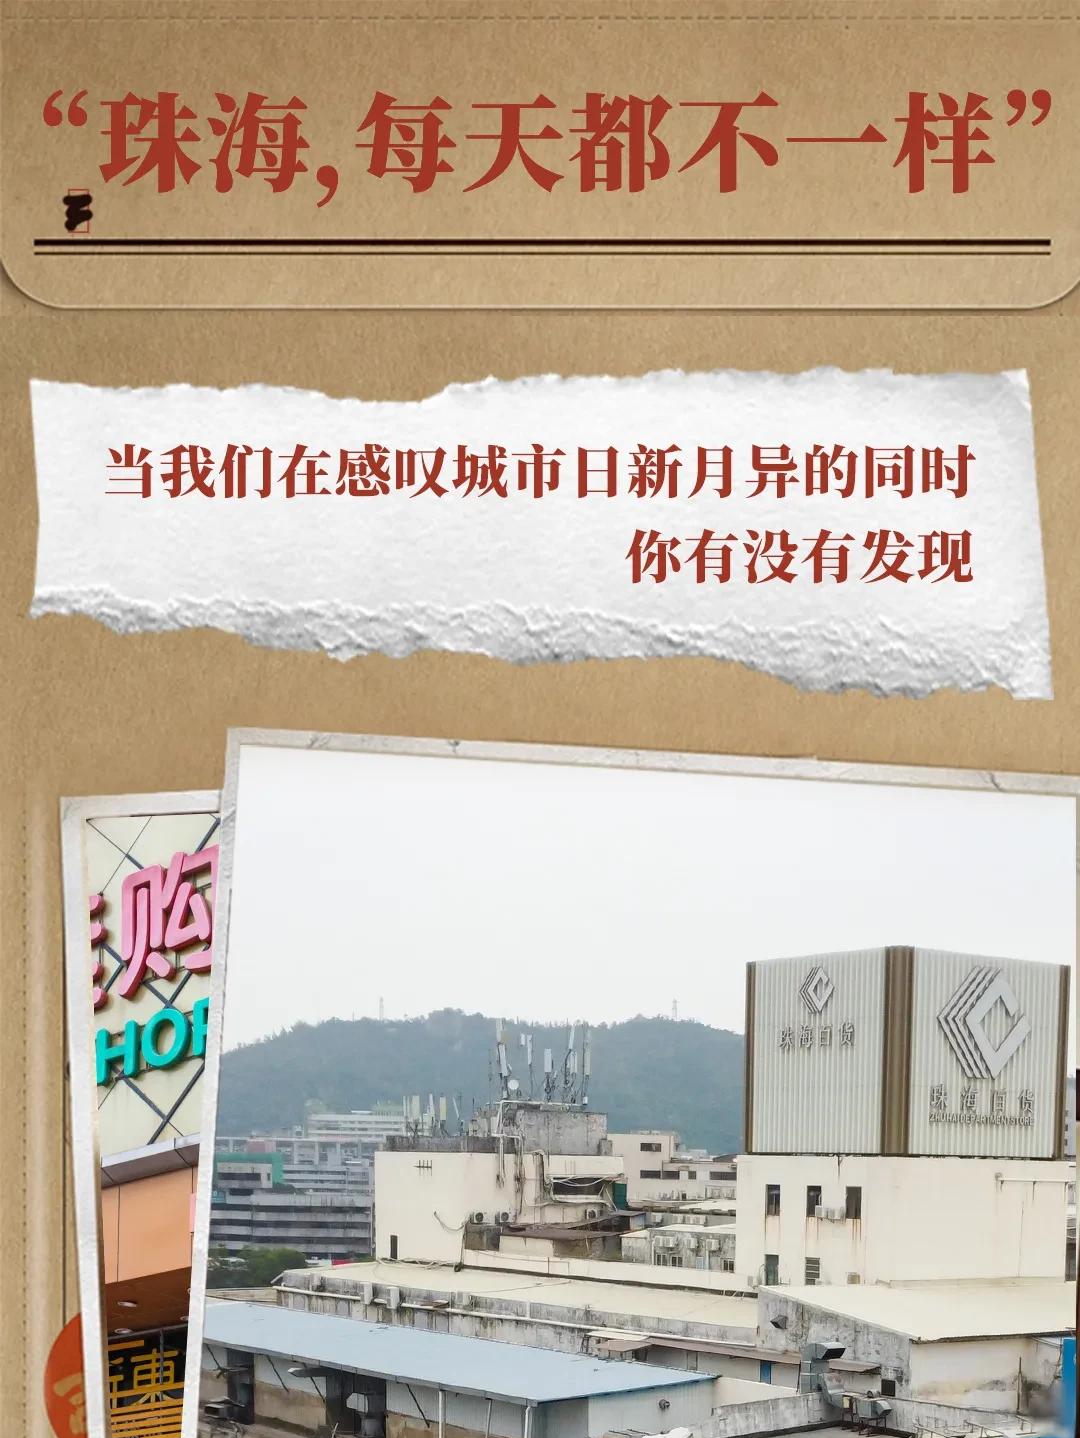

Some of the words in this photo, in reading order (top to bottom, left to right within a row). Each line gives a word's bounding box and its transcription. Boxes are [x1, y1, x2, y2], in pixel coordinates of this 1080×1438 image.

[104, 443, 976, 499] 当我们在感叹城市日新月异的同时
[625, 528, 974, 584] 你有没有发现
[777, 1021, 855, 1049] 珠海百货
[929, 1083, 1035, 1114] 珠海百货
